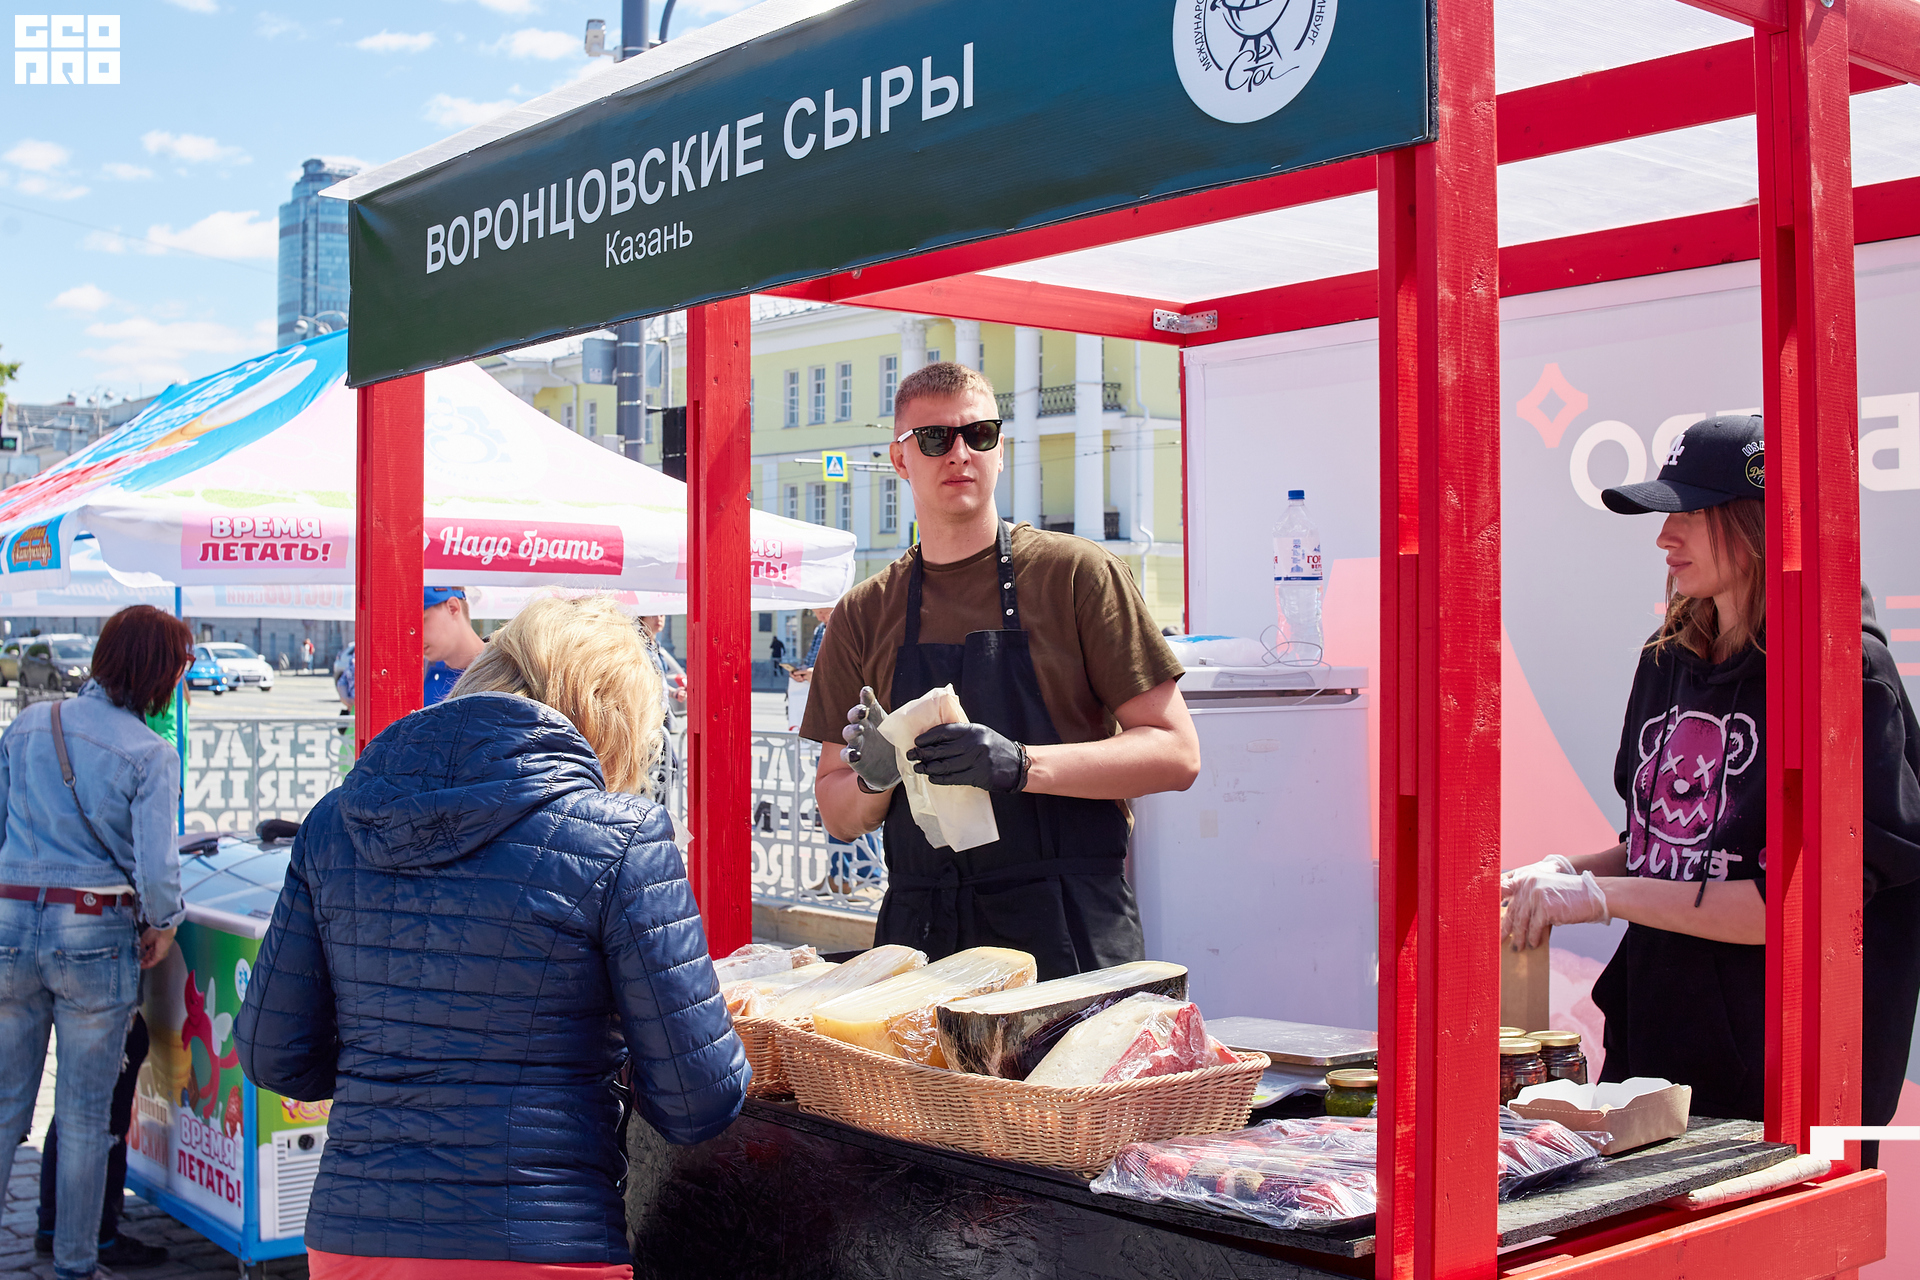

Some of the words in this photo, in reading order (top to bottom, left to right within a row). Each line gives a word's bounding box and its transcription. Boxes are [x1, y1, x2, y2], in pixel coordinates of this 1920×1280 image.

[426, 112, 764, 274] ВОРОНЦОВСКИЕ
[783, 42, 974, 160] СЫРЫ
[605, 221, 694, 268] Казань
[210, 516, 322, 538] ВРЕМЯ
[440, 526, 511, 565] Надо
[518, 529, 604, 566] брать
[198, 541, 332, 563] ЛЕТАТЬ!
[179, 1114, 236, 1170] ВРЕМЯ
[177, 1149, 241, 1208] ЛЕТАТЬ!
